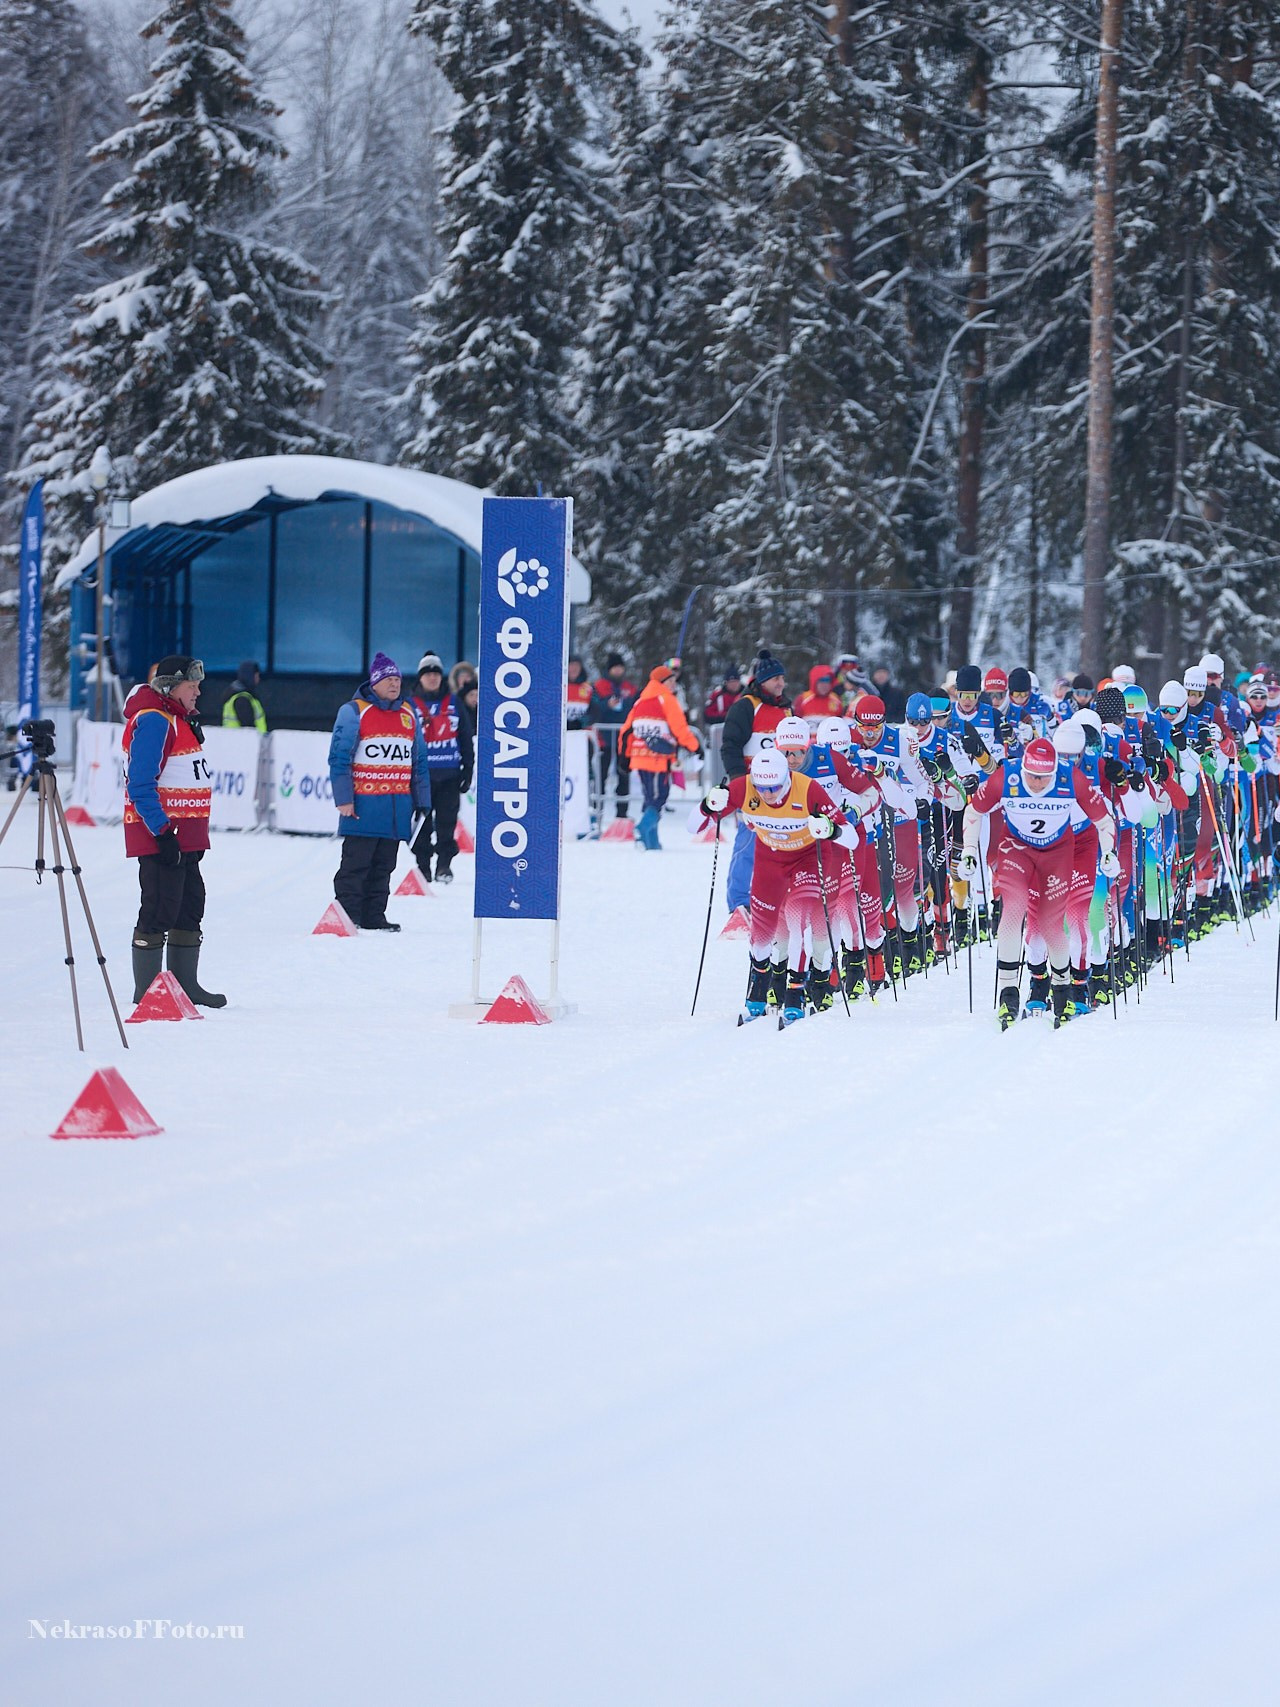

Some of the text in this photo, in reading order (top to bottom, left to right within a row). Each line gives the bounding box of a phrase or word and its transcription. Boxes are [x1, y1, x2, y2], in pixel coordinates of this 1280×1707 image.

[492, 617, 533, 858] ФОСАГРО
[365, 744, 412, 761] СУДЬ
[1019, 802, 1070, 811] ФОСАГРО
[1030, 819, 1046, 834] 2
